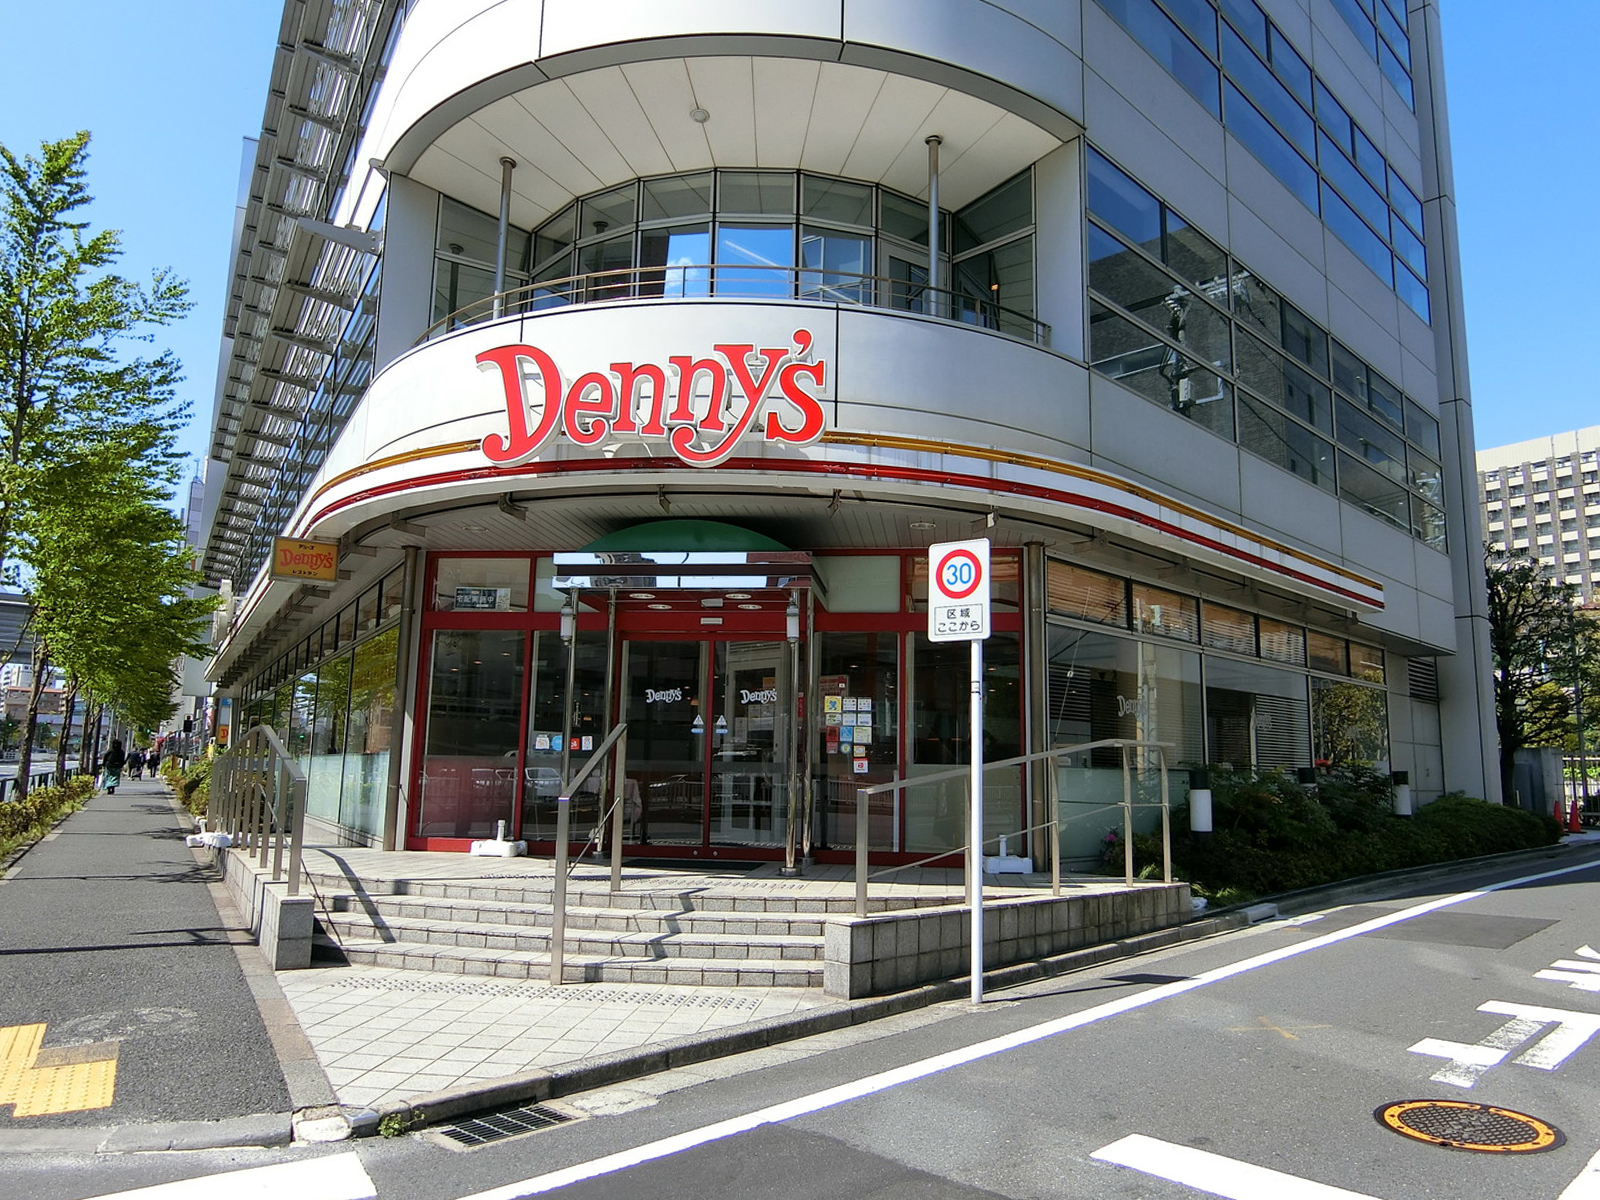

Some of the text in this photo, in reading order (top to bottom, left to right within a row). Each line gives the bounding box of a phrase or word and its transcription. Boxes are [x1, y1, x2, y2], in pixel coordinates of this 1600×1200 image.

[475, 327, 827, 468] Denny's
[279, 548, 334, 570] Denny's
[946, 562, 972, 586] 30
[937, 620, 981, 633] ここから
[645, 687, 682, 704] Denny's
[740, 688, 778, 705] Denny's
